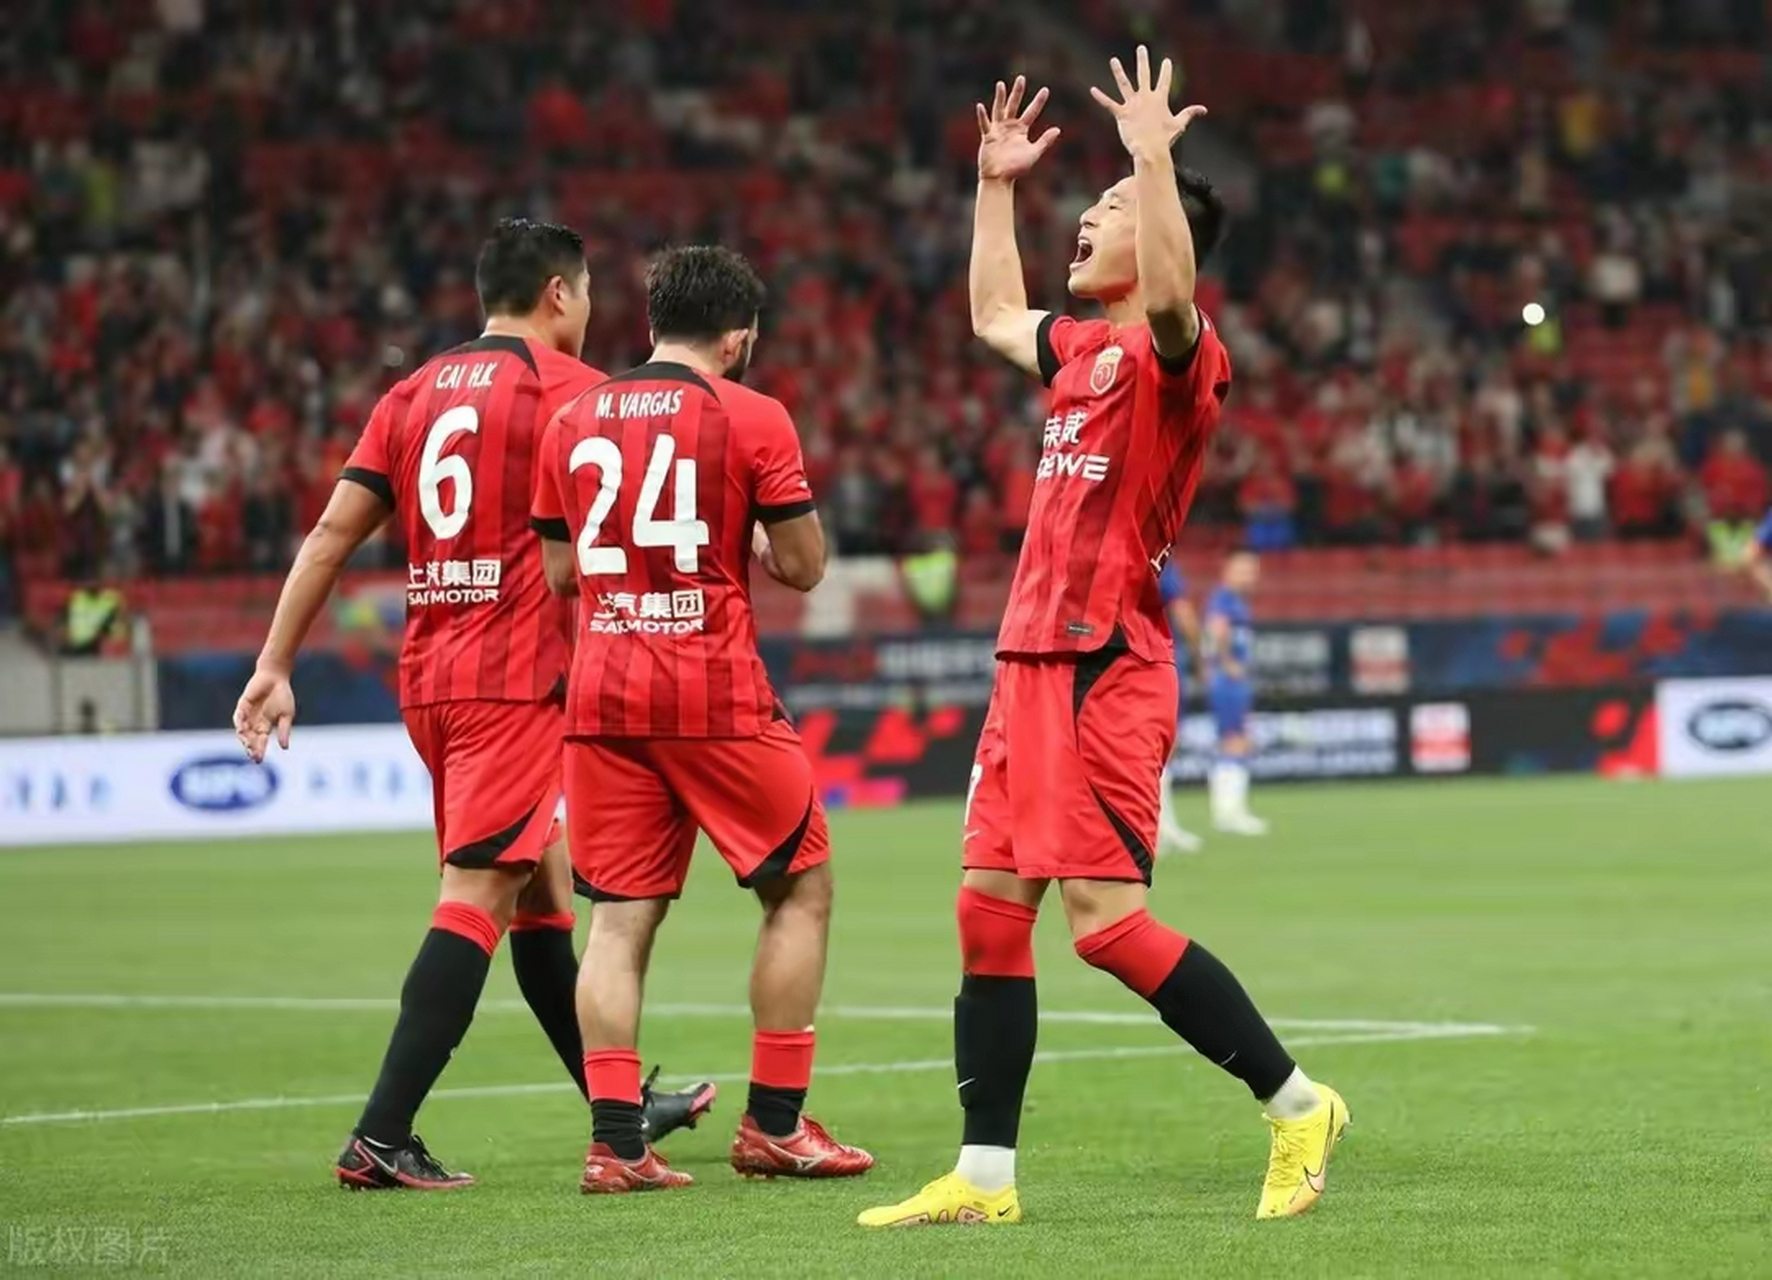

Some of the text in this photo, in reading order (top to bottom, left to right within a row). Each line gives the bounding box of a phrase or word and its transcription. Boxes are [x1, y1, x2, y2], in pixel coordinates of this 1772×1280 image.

[436, 364, 467, 388] CAI
[619, 389, 684, 419] VARGAS
[418, 405, 479, 539] 6
[569, 433, 710, 576] 24
[430, 588, 500, 604] MOTOR
[593, 588, 704, 619] 上汽集团
[626, 618, 704, 635] MOTOR
